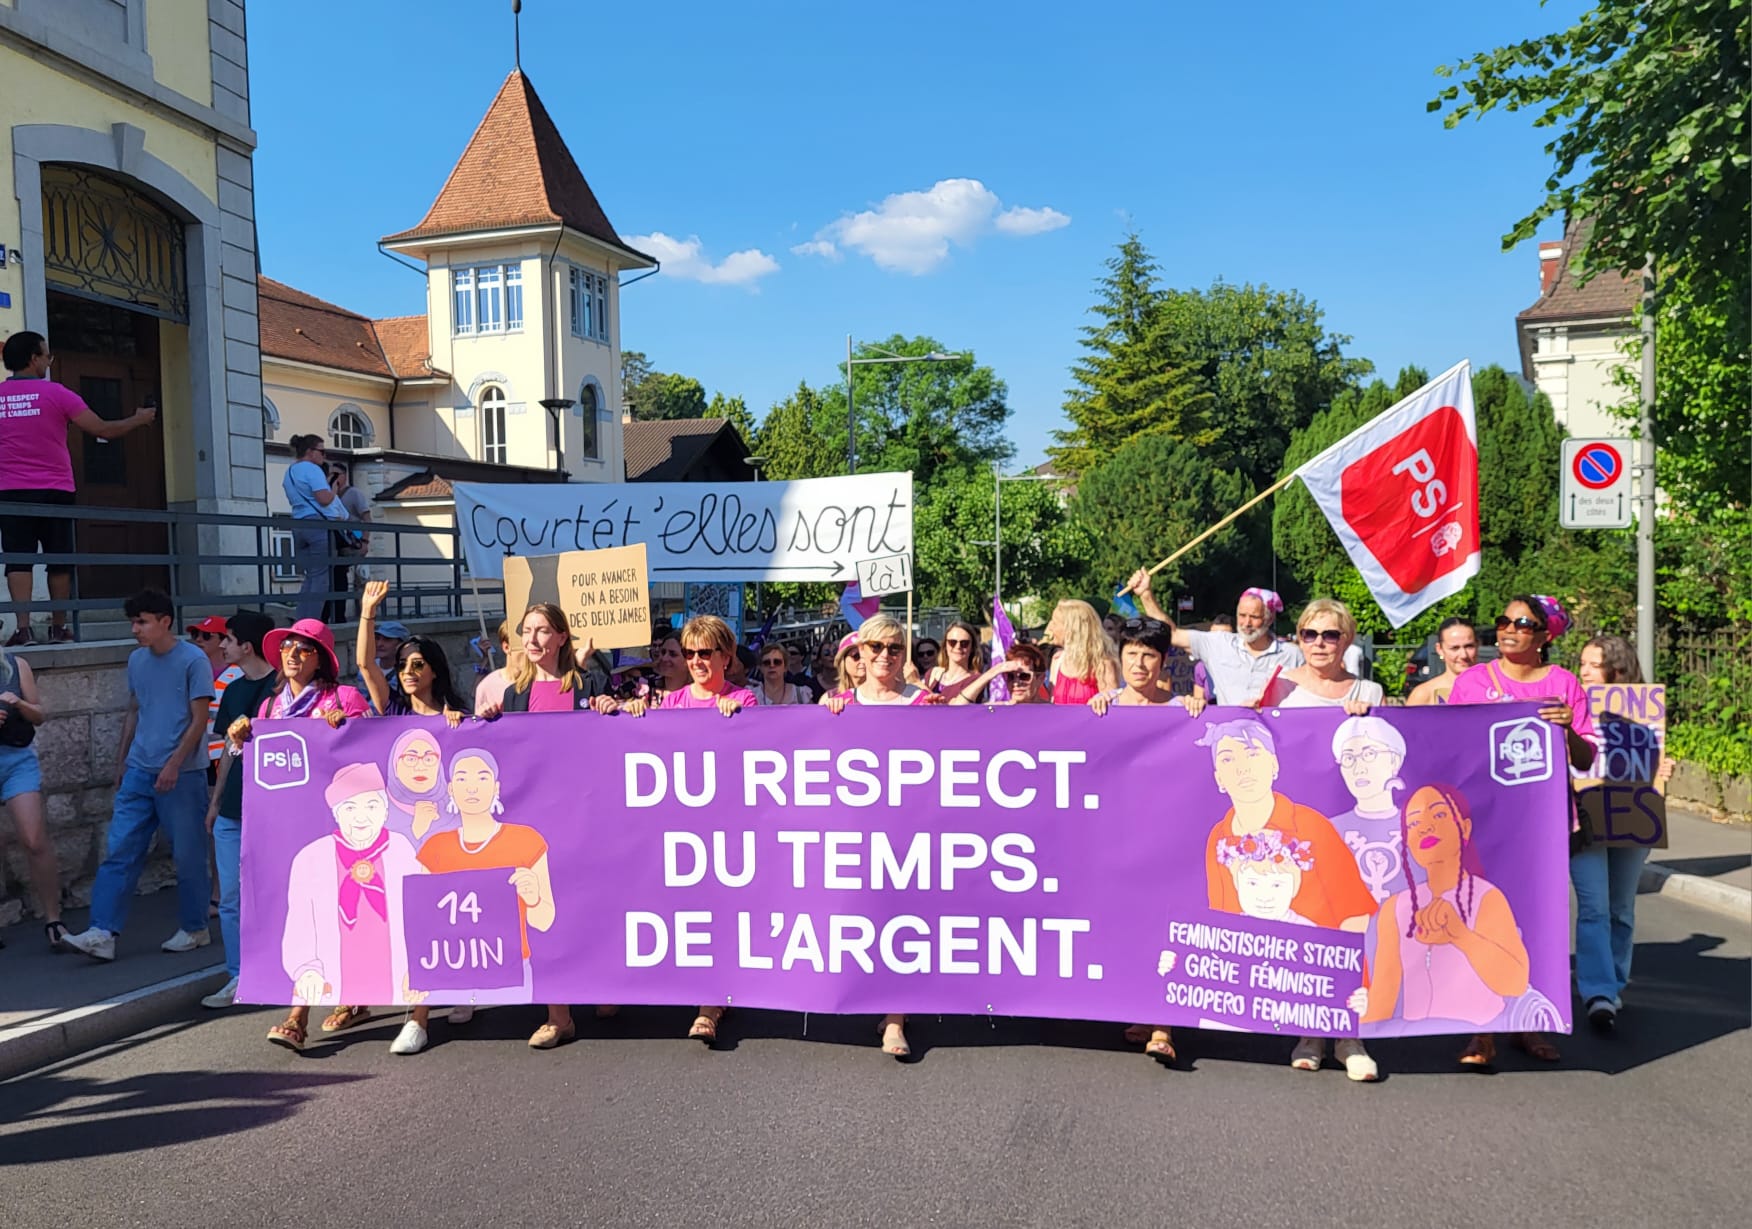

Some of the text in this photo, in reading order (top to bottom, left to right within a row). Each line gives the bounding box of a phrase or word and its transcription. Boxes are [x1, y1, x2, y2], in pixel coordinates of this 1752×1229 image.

[7, 394, 40, 402] RESPECT
[1392, 448, 1447, 518] PS
[1579, 496, 1614, 505] des deux
[787, 488, 907, 553] sont
[571, 568, 637, 587] POUR AVANCER
[866, 556, 907, 593] là!
[580, 587, 639, 606] ON A BESOIN
[569, 606, 647, 628] DES DEUX JAMBES
[1629, 723, 1665, 749] DE
[263, 752, 287, 768] PS
[625, 749, 1100, 810] DU RESPECT.
[664, 830, 1059, 893] DU TEMPS.
[437, 891, 482, 925] 14
[420, 936, 503, 970] JUIN
[626, 911, 1103, 979] DE L’ARGENT.
[1169, 921, 1363, 973] FEMINISTISCHER STREIK
[1185, 952, 1335, 998] GRÈVE FÉMINISTE
[1166, 981, 1352, 1033] SCIOPERO FEMMINISTA
